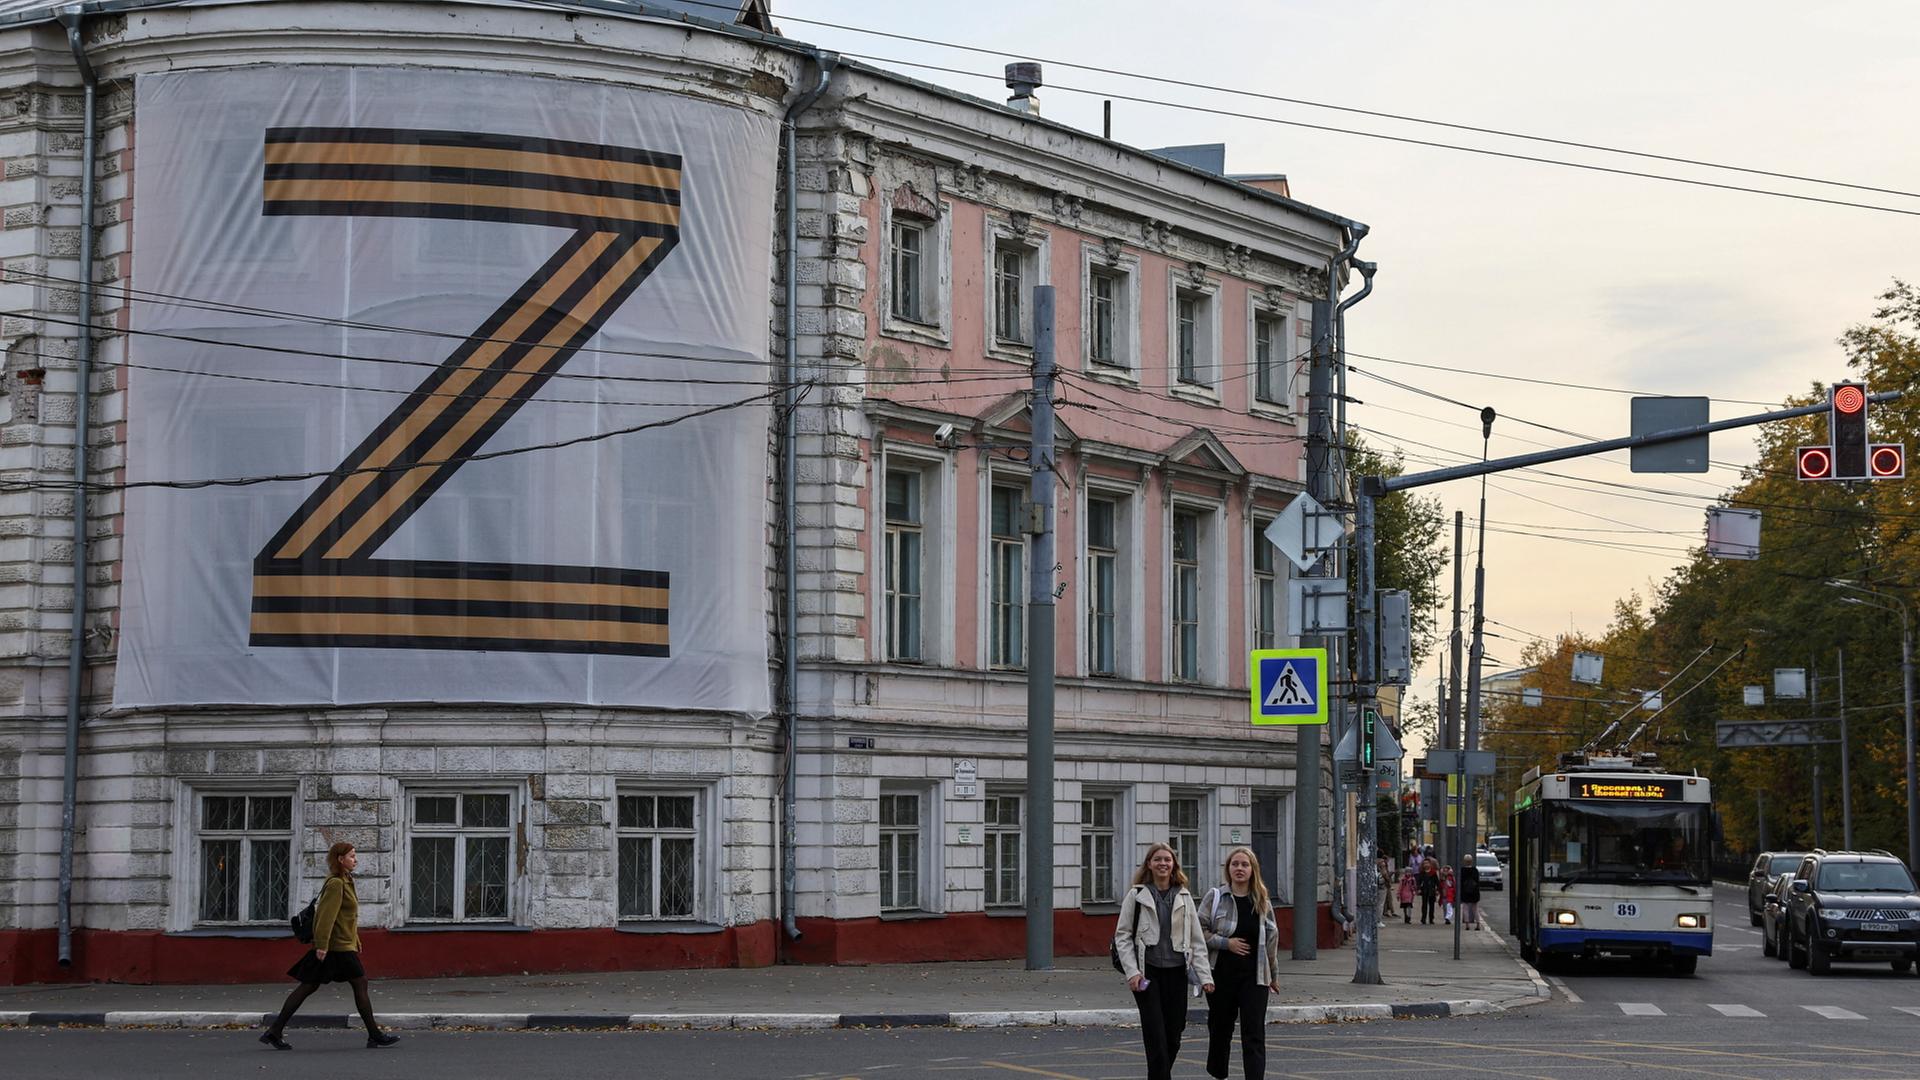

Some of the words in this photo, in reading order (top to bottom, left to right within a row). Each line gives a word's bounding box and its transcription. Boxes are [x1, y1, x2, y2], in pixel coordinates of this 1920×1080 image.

[249, 127, 682, 657] Z
[1582, 784, 1590, 797] 1
[1547, 865, 1554, 878] 1
[1617, 903, 1637, 916] 89
